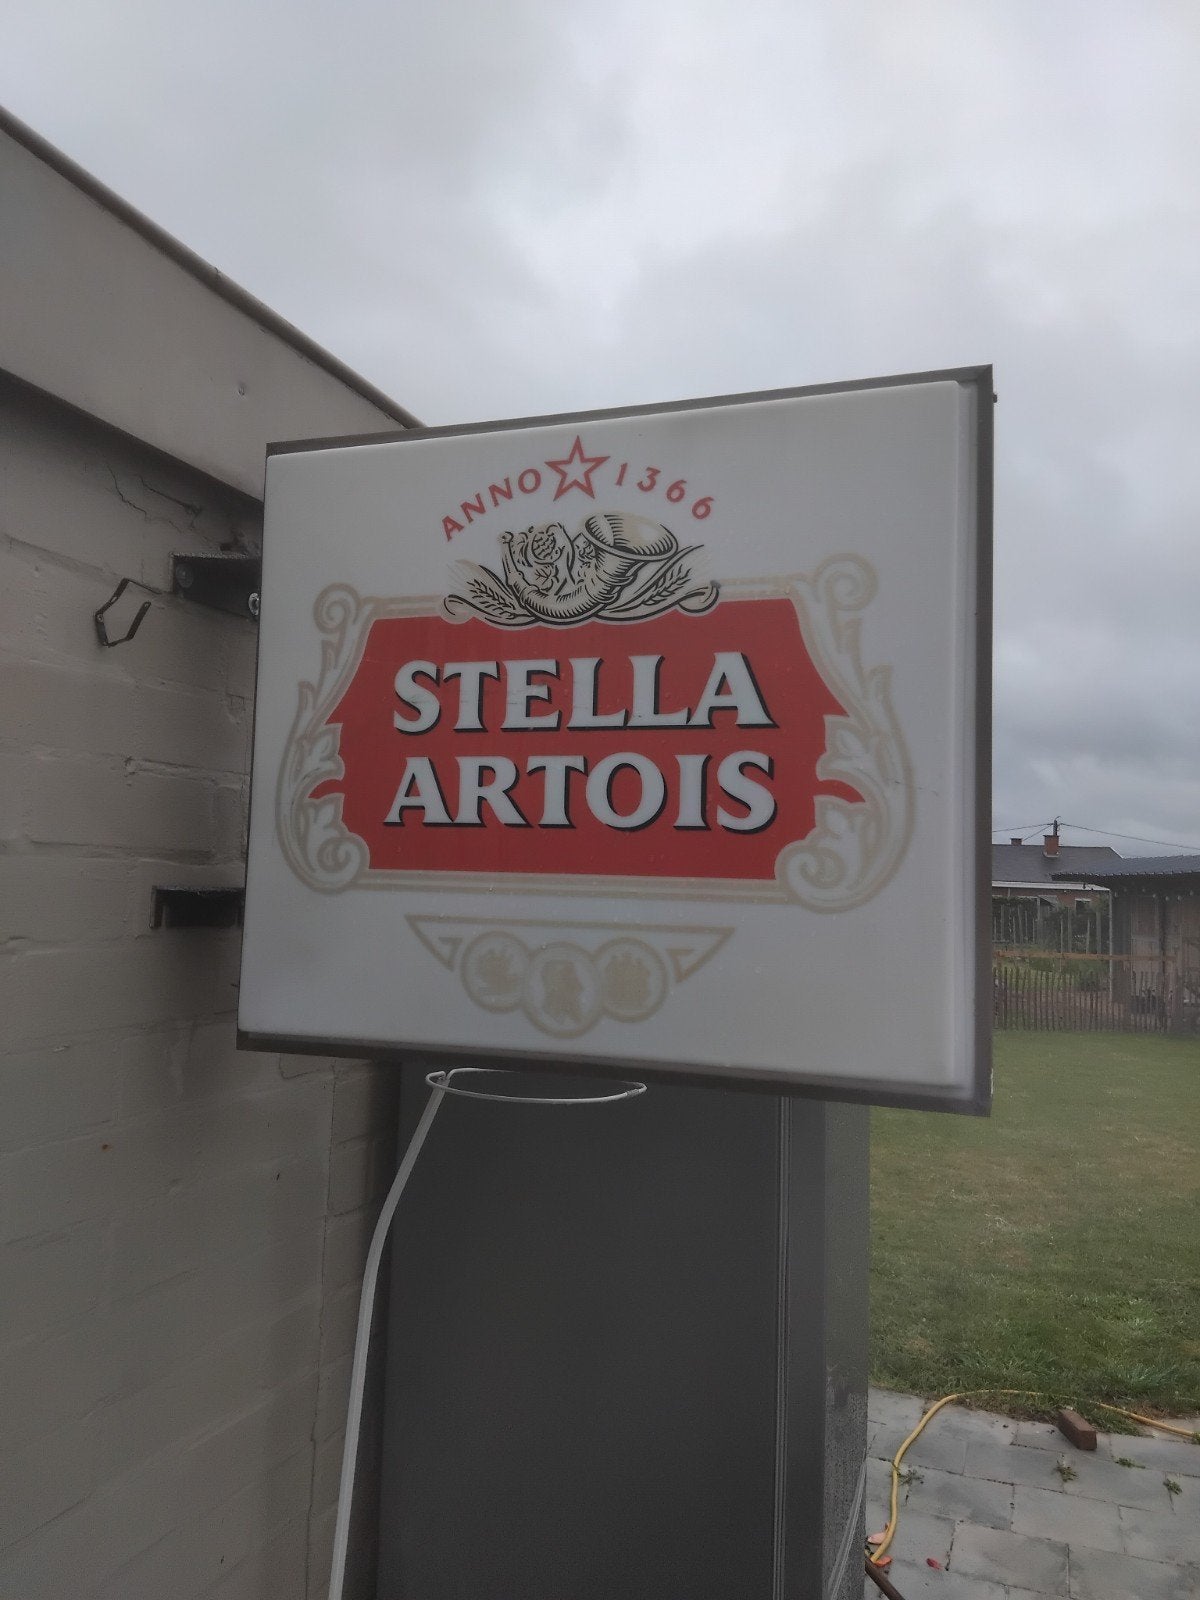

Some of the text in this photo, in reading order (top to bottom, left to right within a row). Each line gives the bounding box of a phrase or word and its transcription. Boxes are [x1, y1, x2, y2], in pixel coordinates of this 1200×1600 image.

[440, 462, 715, 542] ANNO 1366
[393, 651, 780, 735] STELLA
[383, 750, 777, 834] ARTOIS
